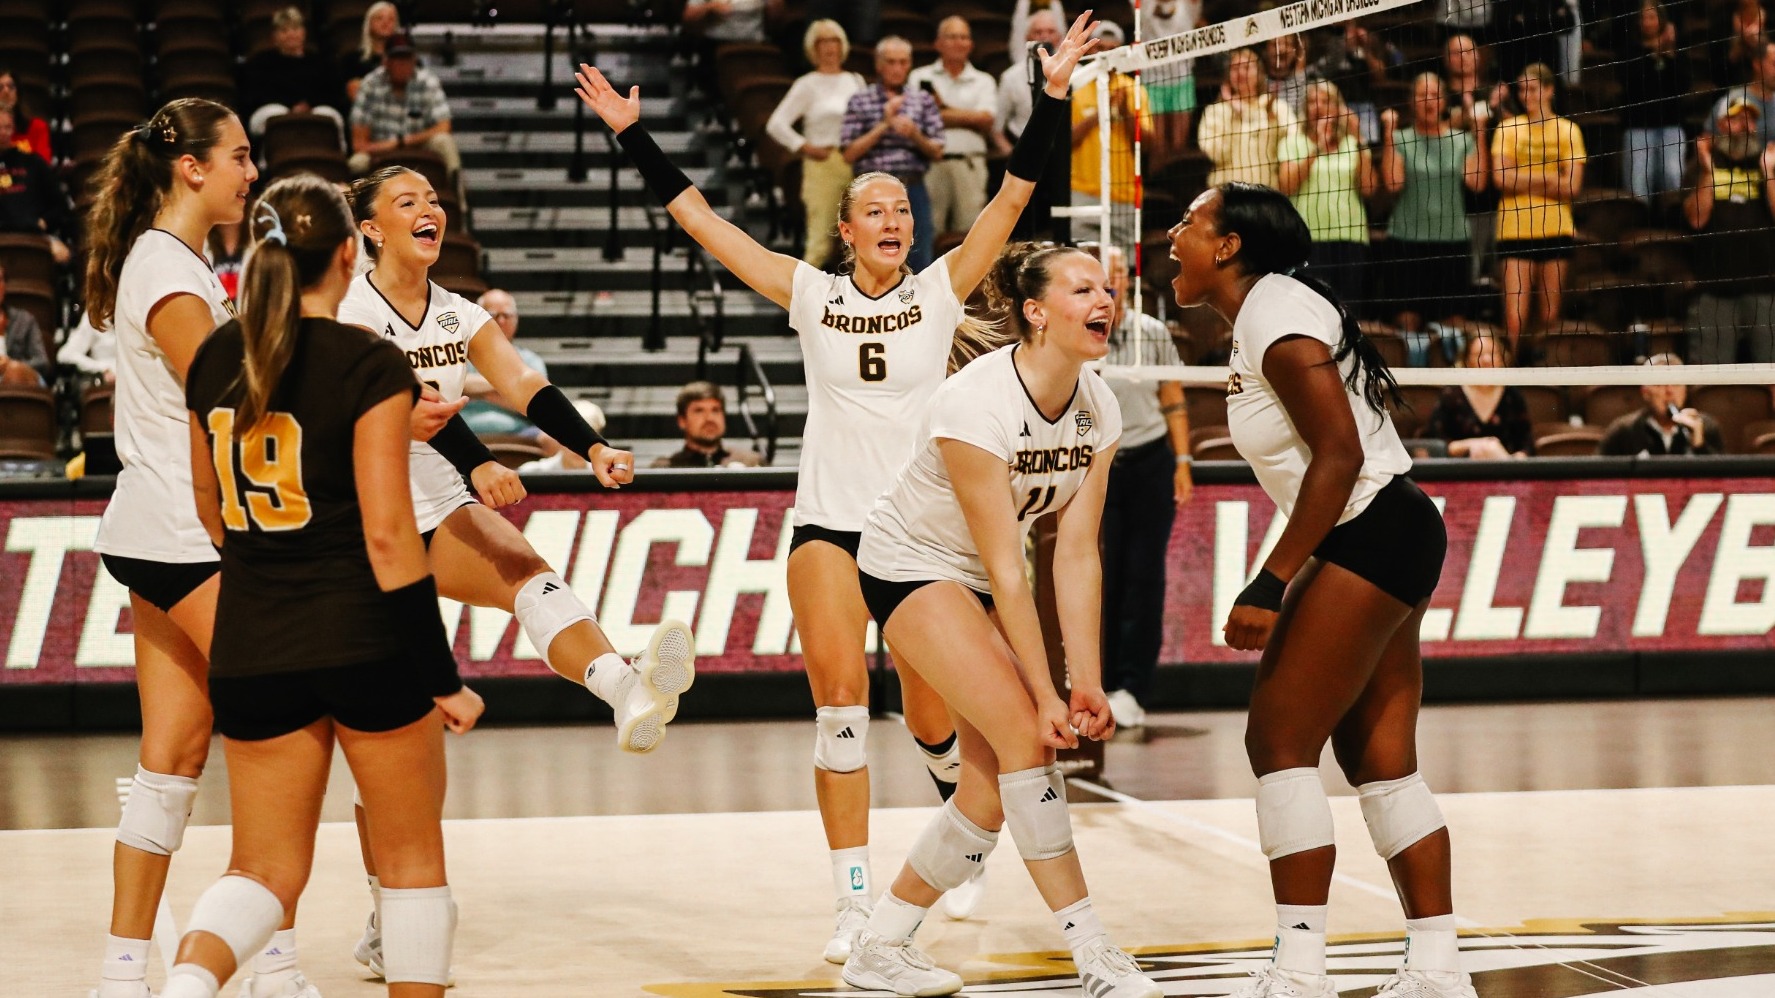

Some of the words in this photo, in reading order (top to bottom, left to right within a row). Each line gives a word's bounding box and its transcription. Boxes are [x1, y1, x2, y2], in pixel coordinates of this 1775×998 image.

[820, 304, 923, 335] BRONCOS
[405, 340, 466, 370] ONCOS
[858, 341, 887, 383] 6
[207, 406, 313, 532] 19
[1014, 444, 1094, 475] BRONCOS
[1017, 485, 1057, 522] 11
[432, 508, 887, 661] MICH
[1211, 493, 1775, 647] VLEYB
